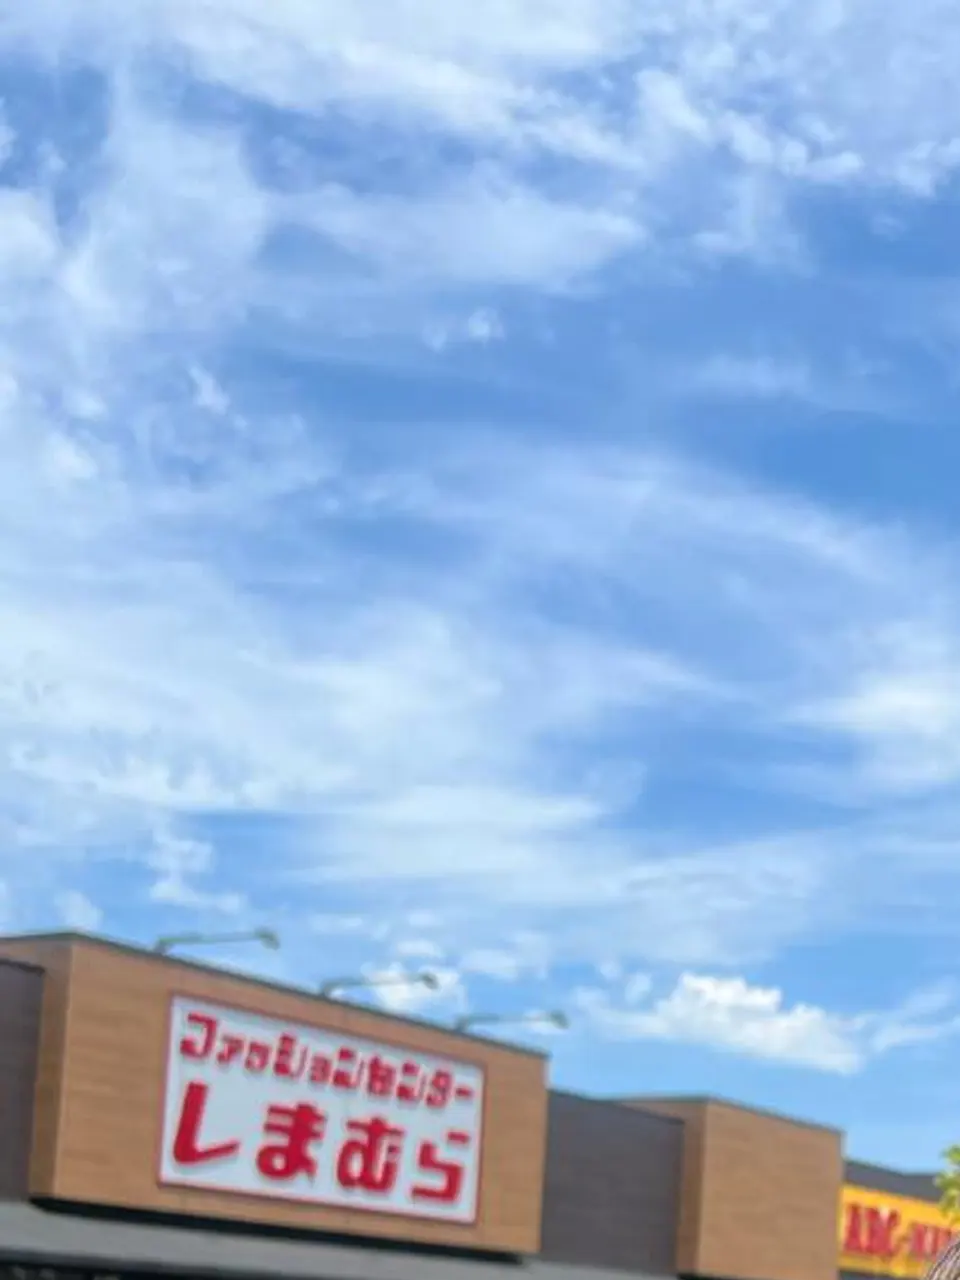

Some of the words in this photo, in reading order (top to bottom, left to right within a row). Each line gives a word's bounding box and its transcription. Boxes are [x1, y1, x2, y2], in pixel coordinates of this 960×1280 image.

[180, 1012, 474, 1108] ファッションセンター
[173, 1081, 470, 1202] しまむら
